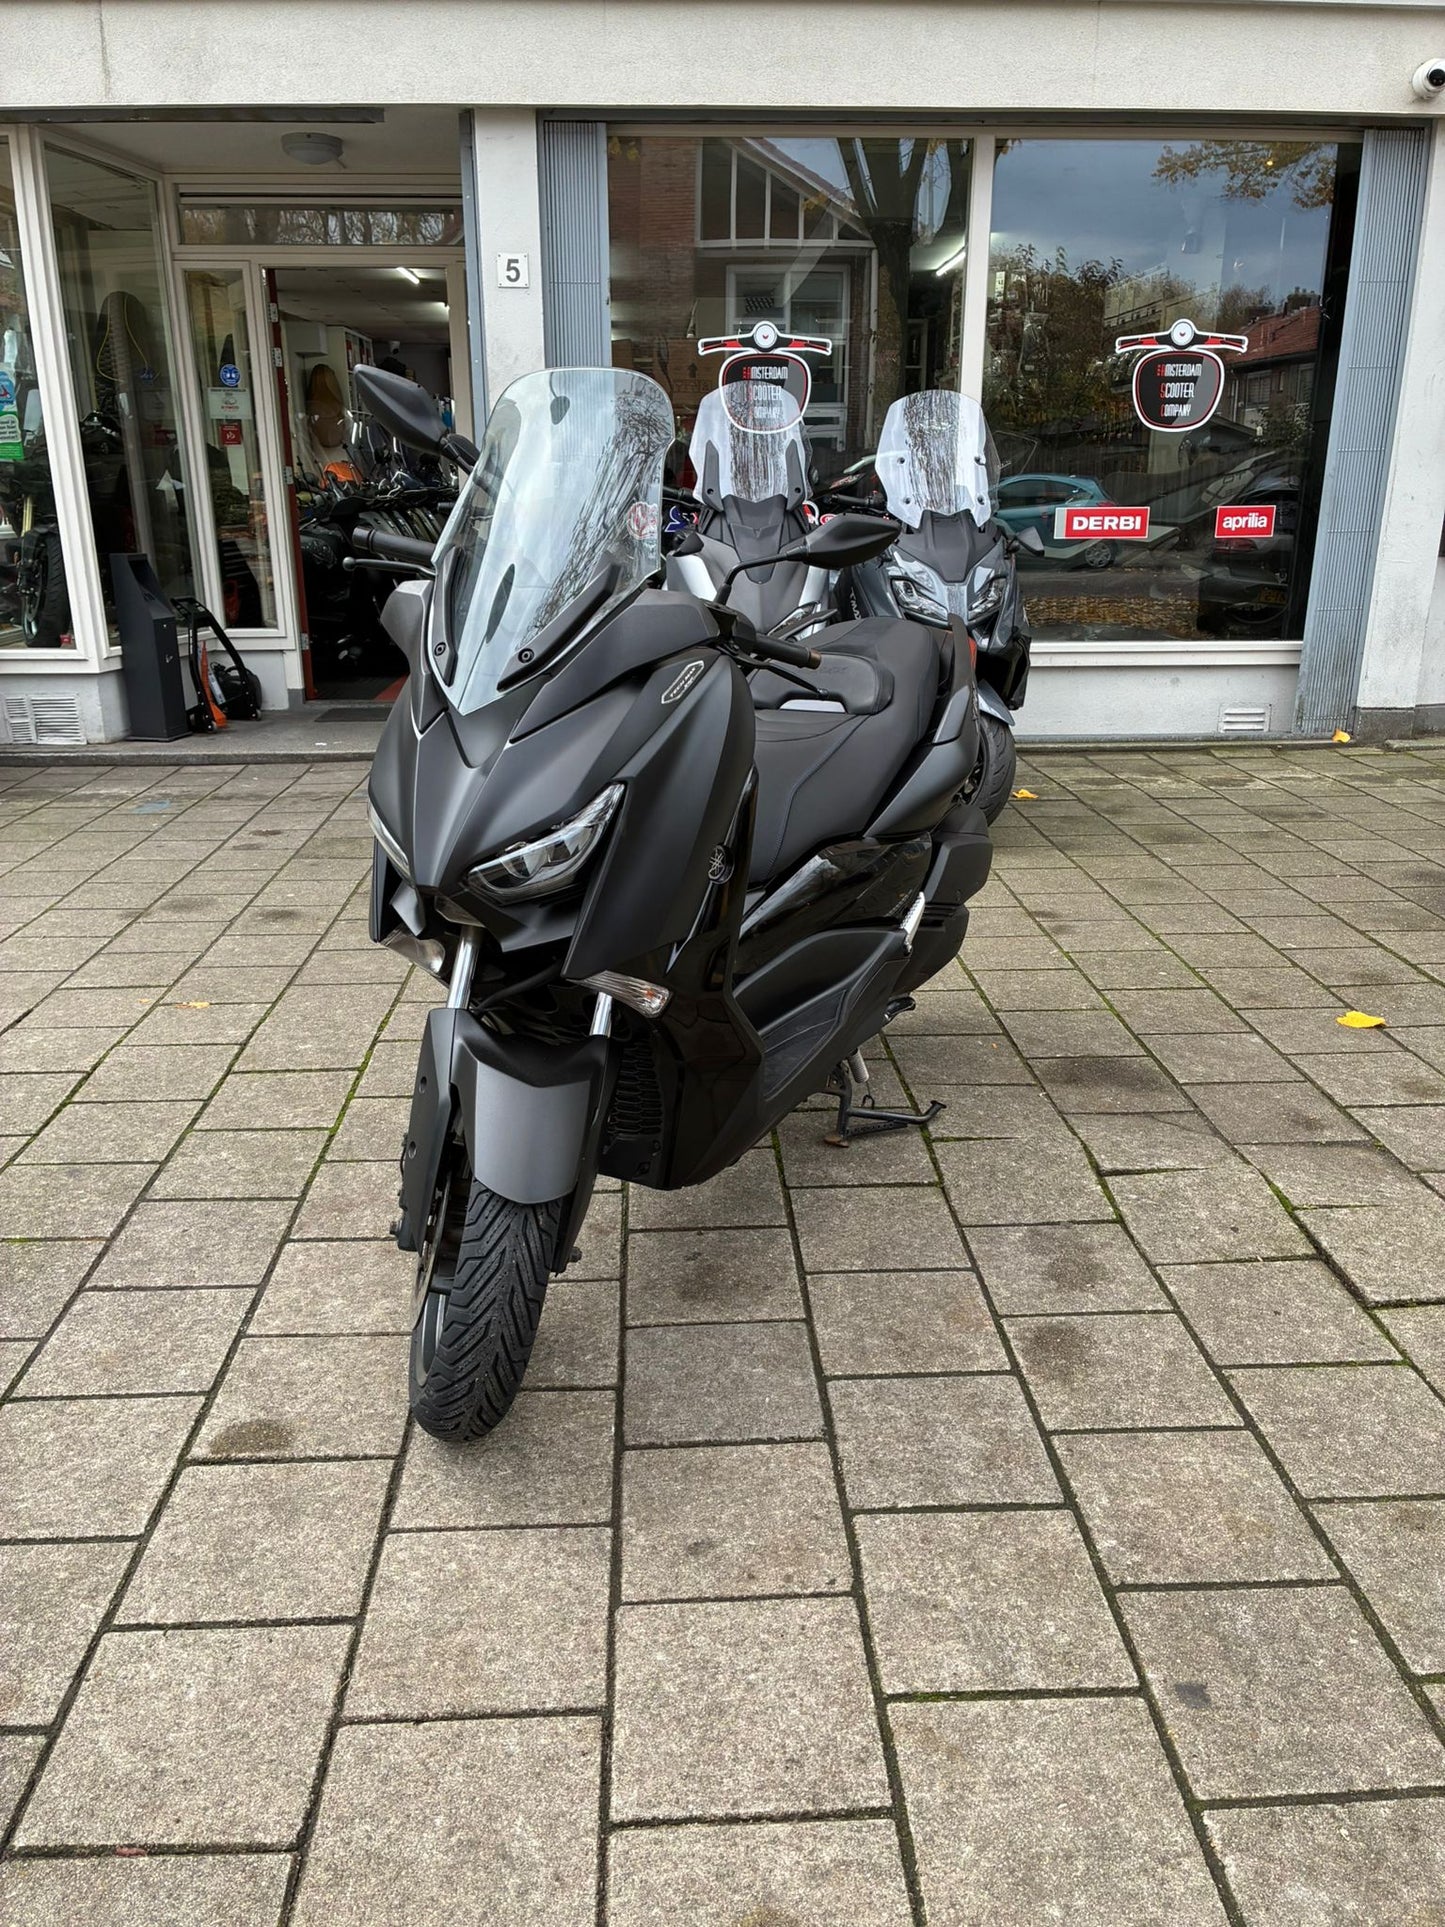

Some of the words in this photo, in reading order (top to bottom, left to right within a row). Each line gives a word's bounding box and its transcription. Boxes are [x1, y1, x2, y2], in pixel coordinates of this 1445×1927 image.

[506, 258, 521, 283] 5
[745, 366, 789, 380] AMSTERDAM
[1160, 363, 1204, 377] AMSTERDAM
[1160, 382, 1195, 399] SCOOTER
[1160, 404, 1192, 417] COMPANY
[1072, 516, 1142, 531] DERBI
[1222, 512, 1267, 531] aprilia
